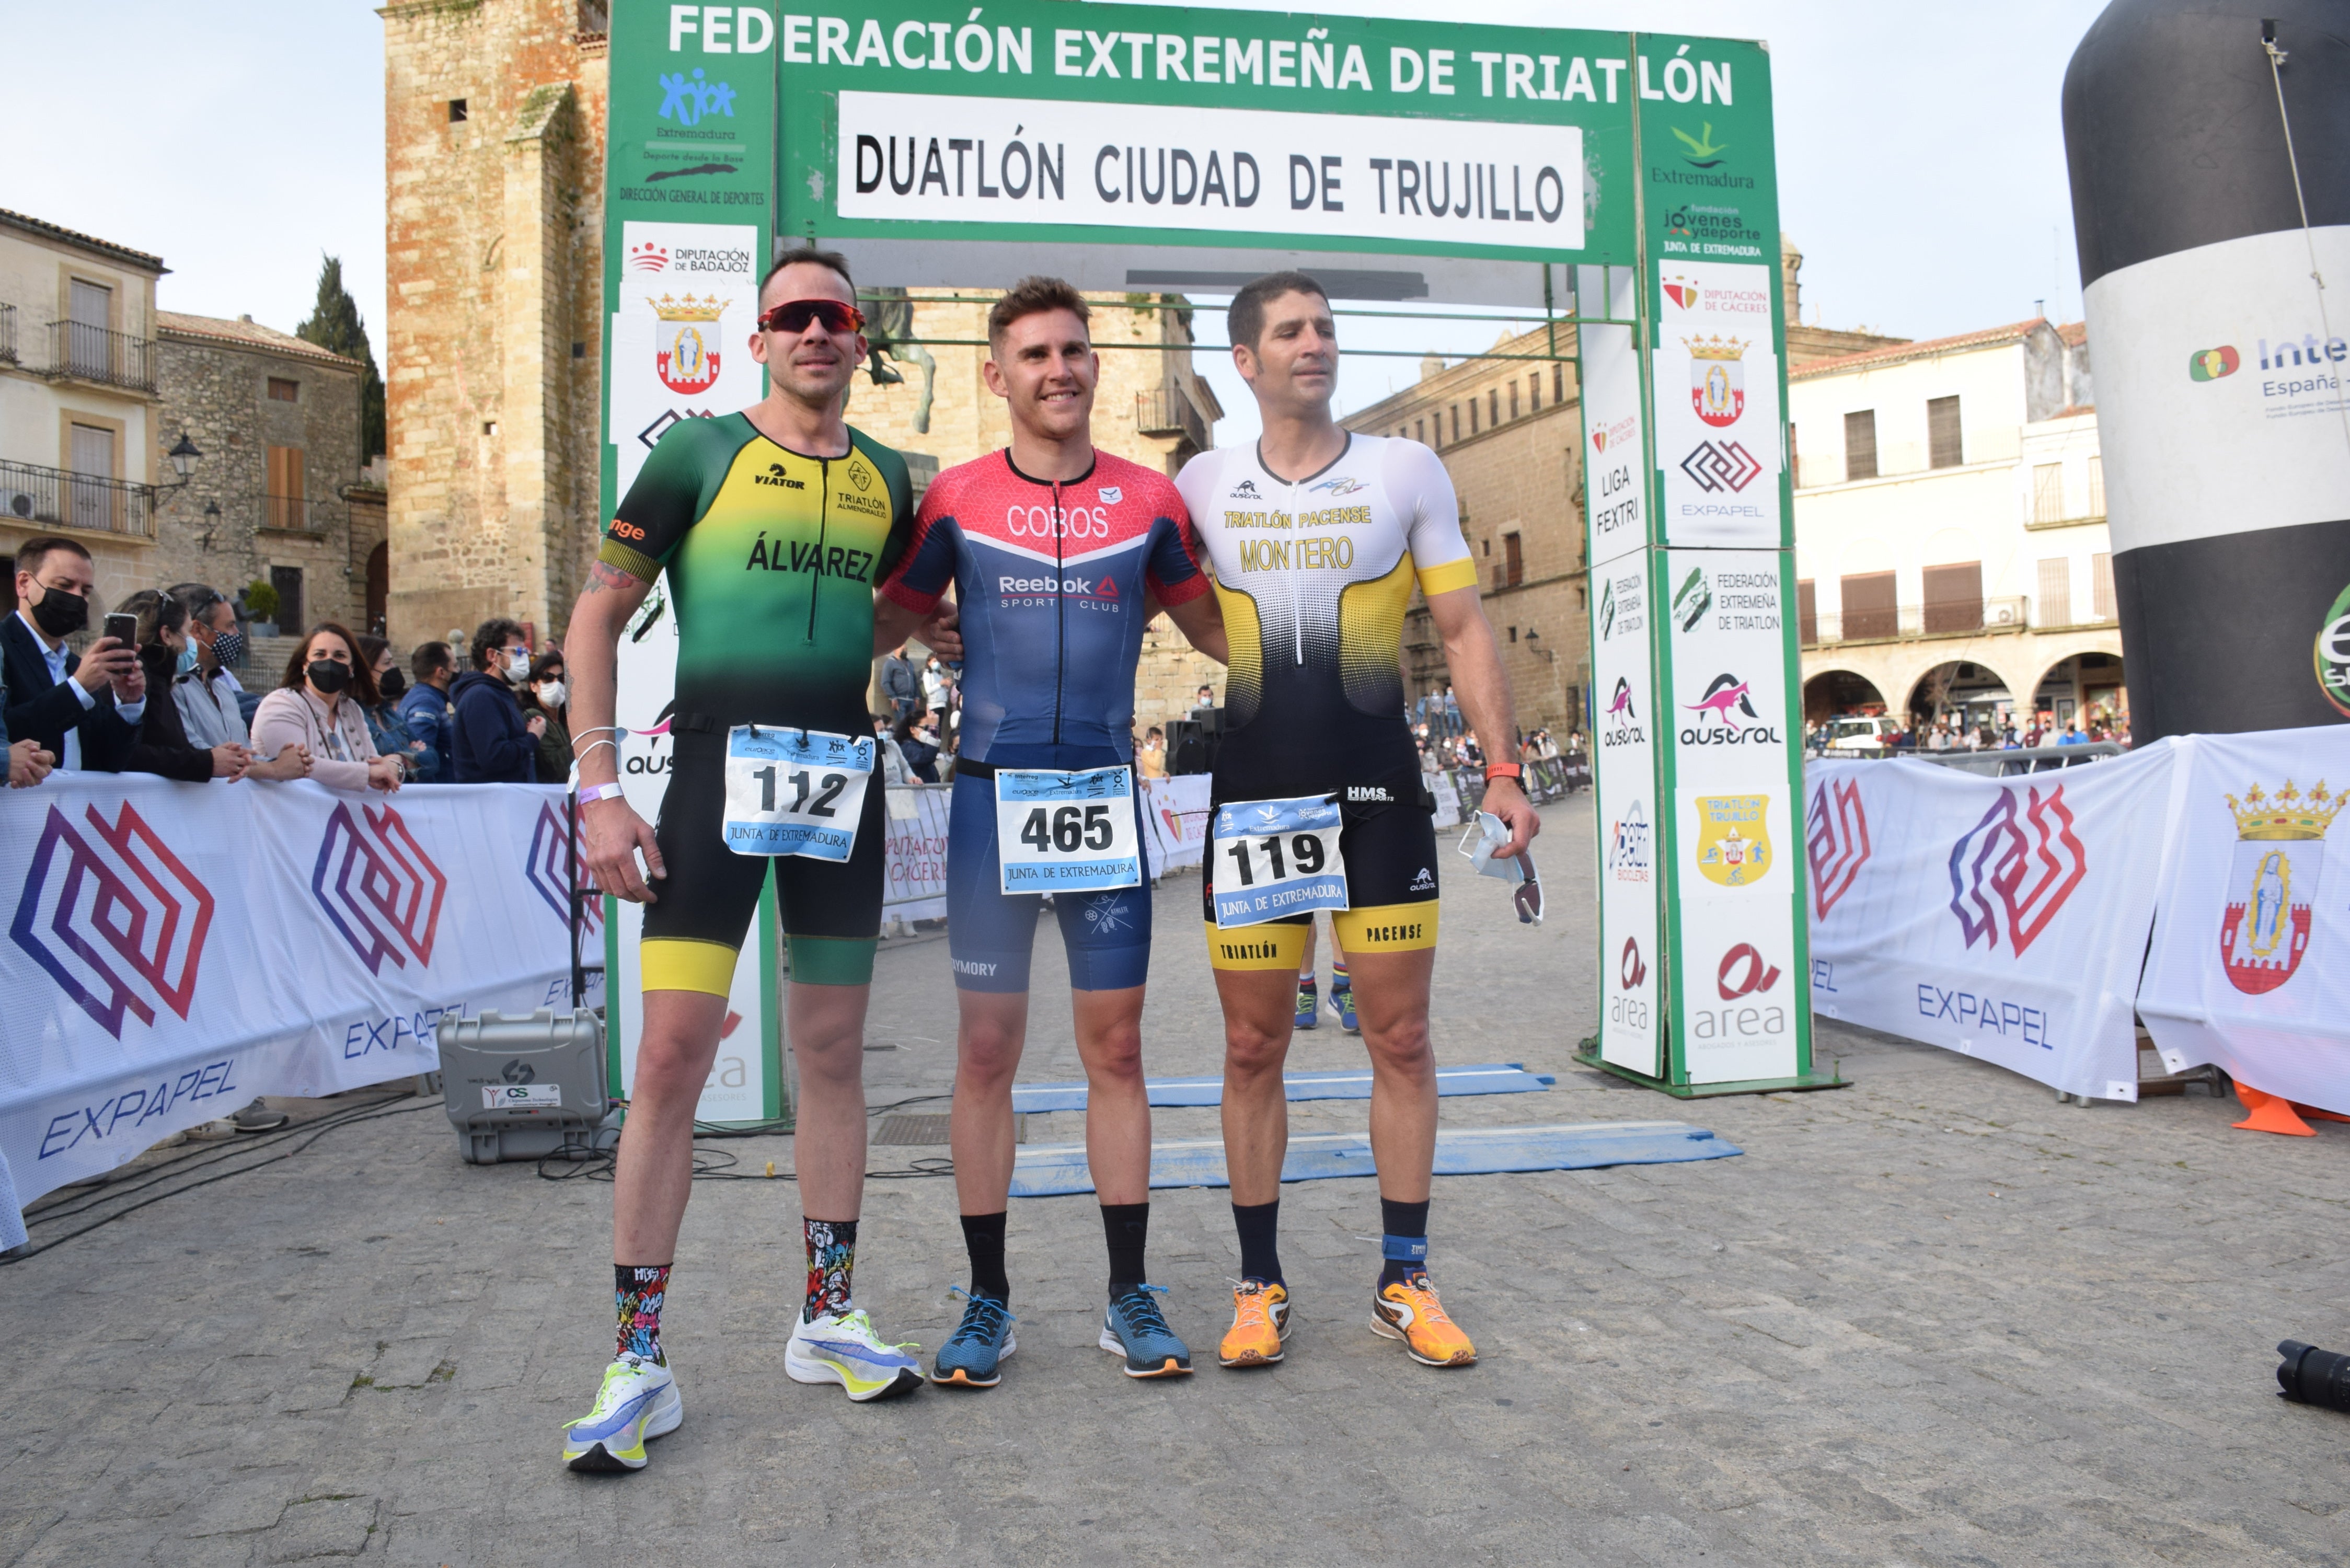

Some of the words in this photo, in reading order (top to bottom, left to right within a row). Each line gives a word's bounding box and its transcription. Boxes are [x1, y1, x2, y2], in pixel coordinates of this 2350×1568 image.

[670, 5, 1032, 75] FEDERACIÓN
[1055, 28, 1373, 91] EXTREMEÑA
[1391, 47, 1455, 96] DE
[1471, 45, 1733, 106] TRIATLÓN
[656, 127, 735, 140] Extremadura
[643, 152, 679, 162] Deporte
[682, 153, 709, 162] desde
[712, 154, 720, 163] la
[724, 154, 744, 163] Base
[856, 123, 1065, 201] DUATLÓN
[1095, 144, 1261, 208] CIUDAD
[1289, 154, 1344, 212] DE
[1369, 158, 1564, 224] TRUJILLO
[1652, 167, 1755, 189] Extremadura
[620, 187, 666, 202] DIRECCIÓN
[669, 189, 708, 204] GENERAL
[710, 191, 721, 204] DE
[723, 192, 765, 205] DEPORTES
[675, 248, 750, 261] DIPUTACIÓN
[1663, 240, 1688, 252] JUNTA
[1690, 243, 1701, 253] DE
[1703, 244, 1762, 257] EXTREMADURA
[675, 262, 687, 271] DE
[690, 261, 749, 273] BADAJOZ
[1704, 288, 1767, 302] DIPUTACIÓN
[1704, 302, 1717, 311] DE
[1721, 299, 1768, 313] CÁCERES
[2263, 374, 2339, 397] España
[754, 475, 805, 491] VIATOR
[1602, 465, 1630, 497] LIGA
[837, 503, 886, 519] ALMENDRALEJO
[838, 492, 885, 511] TRIATLÓN
[1681, 504, 1765, 518] EXPAPEL
[1007, 505, 1109, 539] COBOS
[1224, 509, 1292, 529] TRIATLÓN
[1299, 506, 1372, 528] PACENSE
[1597, 497, 1638, 536] FEXTRI
[746, 531, 874, 583] ÁLVAREZ
[1240, 536, 1354, 573] MONTERO
[998, 575, 1092, 594] Reebok
[1718, 571, 1777, 588] FEDERACIÓN
[1000, 597, 1056, 608] SPORT
[1079, 600, 1119, 614] CLUB
[1720, 593, 1777, 609] EXTREMEÑA
[1719, 616, 1732, 630] DE
[1605, 726, 1645, 747] austral
[1680, 727, 1782, 745] austral
[753, 765, 848, 818] 112
[1347, 786, 1387, 799] HMS
[1707, 798, 1761, 810] TRIATLÓN
[1708, 811, 1759, 823] TRUJILLO
[730, 827, 764, 840] JUNTA
[769, 828, 779, 841] DE
[781, 829, 847, 848] EXTREMADURA
[1020, 804, 1114, 854] 465
[1249, 824, 1290, 832] Extremadura
[1227, 834, 1326, 886] 119
[1008, 868, 1039, 882] JUNTA
[1043, 867, 1055, 879] DE
[1060, 862, 1135, 878] EXTREMADURA
[1410, 881, 1436, 892] austral
[1220, 900, 1251, 918] JUNTA
[1255, 897, 1269, 911] DE
[1273, 885, 1343, 907] EXTREMADURA
[1367, 923, 1422, 942] PACENSE
[1220, 940, 1277, 960] TRIATLÓN
[1611, 996, 1647, 1030] area
[1694, 1006, 1784, 1039] area
[1917, 983, 2053, 1051] EXPAPEL
[1698, 1041, 1735, 1050] ABOGADOS
[1744, 1039, 1777, 1048] ASESORES
[506, 1088, 528, 1098] CS
[37, 1059, 237, 1160] EXPAPEL
